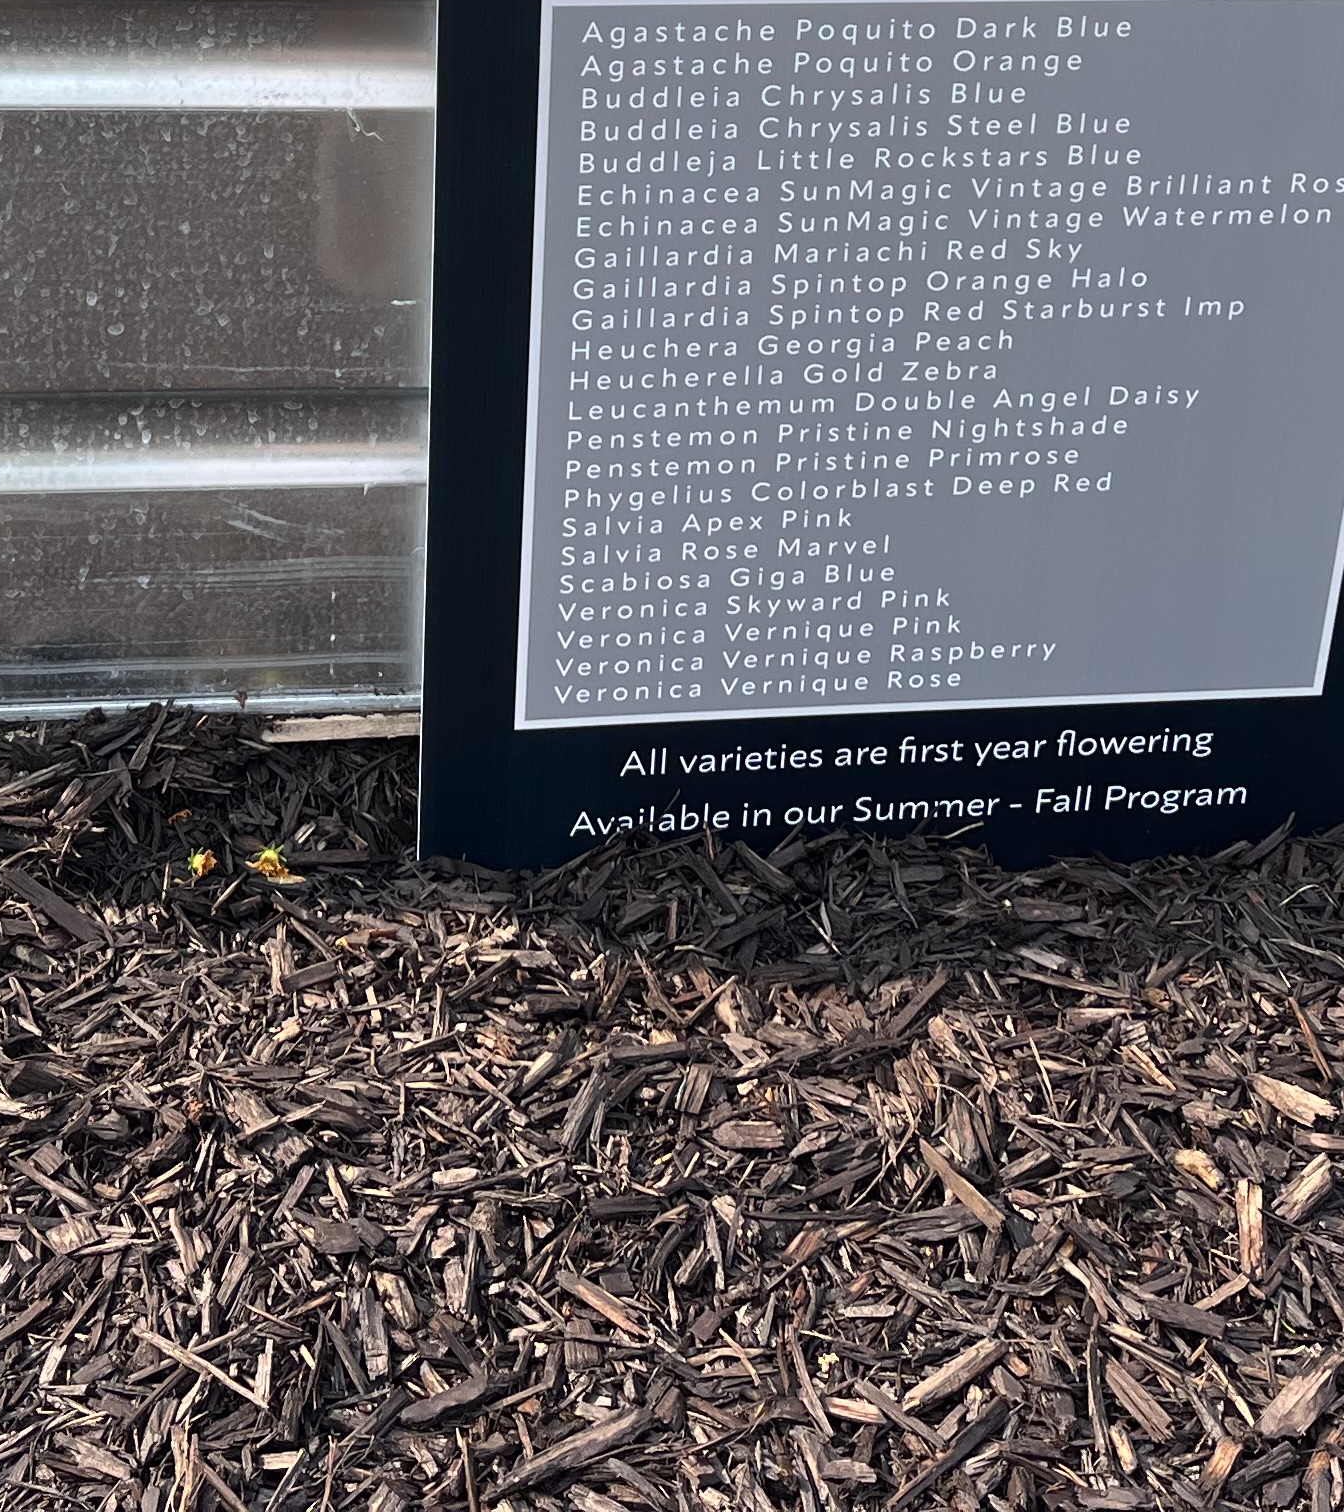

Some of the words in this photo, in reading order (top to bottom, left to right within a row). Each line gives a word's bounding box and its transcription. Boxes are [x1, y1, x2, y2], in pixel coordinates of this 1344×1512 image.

[581, 18, 776, 50] Agastache
[795, 17, 936, 46] Poquito
[956, 15, 1037, 40] Dark
[1056, 15, 1132, 38] Blue
[580, 51, 773, 83] Agastache
[793, 50, 933, 80] Poquito
[952, 49, 1083, 77] Orange
[581, 85, 740, 110] Buddleia
[760, 82, 931, 112] Chrysalis
[950, 81, 1026, 105] Blue
[580, 117, 738, 143] Buddleia
[758, 114, 928, 144] Chrysalis
[946, 112, 1037, 137] Steel
[1056, 112, 1131, 135] Blue
[579, 149, 736, 178] Buddleja
[757, 147, 855, 171] Little
[874, 145, 1048, 169] Rockstars
[1066, 143, 1142, 166] Blue
[577, 183, 760, 207] Echinacea
[779, 178, 952, 206] SunMagic
[971, 177, 1108, 204] Vintage
[1126, 173, 1273, 197] Brilliant
[576, 214, 758, 238] Echinacea
[777, 209, 949, 237] SunMagic
[967, 208, 1104, 234] Vintage
[1122, 202, 1332, 227] Watermelon
[574, 243, 753, 270] Gaillardia
[774, 239, 928, 265] Mariachi
[946, 238, 1007, 261] Red
[1025, 237, 1083, 265] Sky
[572, 274, 751, 301] Gaillardia
[770, 273, 907, 301] Spintop
[926, 270, 1053, 296] Orange
[1071, 266, 1148, 289] Halo
[571, 305, 749, 332] Gaillardia
[768, 302, 905, 331] Spintop
[923, 299, 984, 322] Red
[1002, 297, 1167, 321] Starburst
[1184, 296, 1245, 321] Imp
[570, 336, 738, 361] Heuchera
[757, 332, 895, 360] Georgia
[915, 328, 1013, 353] Peach
[569, 364, 784, 392] Heucherella
[803, 361, 884, 385] Gold
[900, 359, 997, 382] Zebra
[568, 395, 835, 422] Leucanthemum
[855, 388, 976, 412] Double
[992, 385, 1091, 413] Angel
[1108, 384, 1200, 409] Daisy
[567, 429, 758, 451] Penstemon
[777, 421, 913, 444] Pristine
[931, 414, 1128, 444] Nightshade
[565, 458, 756, 480] Penstemon
[775, 450, 910, 473] Pristine
[928, 447, 1080, 468] Primrose
[564, 483, 732, 513] Phygelius
[750, 477, 935, 503] Colorblast
[952, 475, 1036, 499] Deep
[1053, 471, 1112, 493] Red
[561, 514, 663, 538] Salvia
[680, 512, 764, 537] Apex
[781, 507, 852, 530] Pink
[560, 543, 663, 568] Salvia
[681, 541, 759, 562] Rose
[778, 533, 891, 557] Marvel
[559, 571, 711, 595] Scabiosa
[729, 566, 805, 591] Giga
[824, 562, 895, 584] Blue
[557, 598, 707, 623] Veronica
[725, 589, 863, 619] Skyward
[880, 587, 950, 609] Pink
[556, 626, 706, 650] Veronica
[724, 619, 874, 643] Vernique
[892, 614, 961, 637] Pink
[555, 653, 704, 678] Veronica
[722, 646, 872, 671] Vernique
[889, 640, 1057, 665] Raspberry
[553, 680, 702, 705] Veronica
[720, 673, 870, 697] Vernique
[887, 668, 963, 691] Rose
[620, 747, 667, 777] All
[679, 744, 823, 774] varieties
[834, 745, 888, 768] are
[899, 736, 964, 764] first
[974, 739, 1047, 767] year
[1057, 727, 1214, 758] flowering
[742, 802, 772, 828] in
[784, 803, 844, 825] our
[853, 795, 1001, 823] Summer
[1008, 802, 1023, 810] -
[1035, 785, 1092, 813] Fall
[1105, 783, 1248, 814] Program
